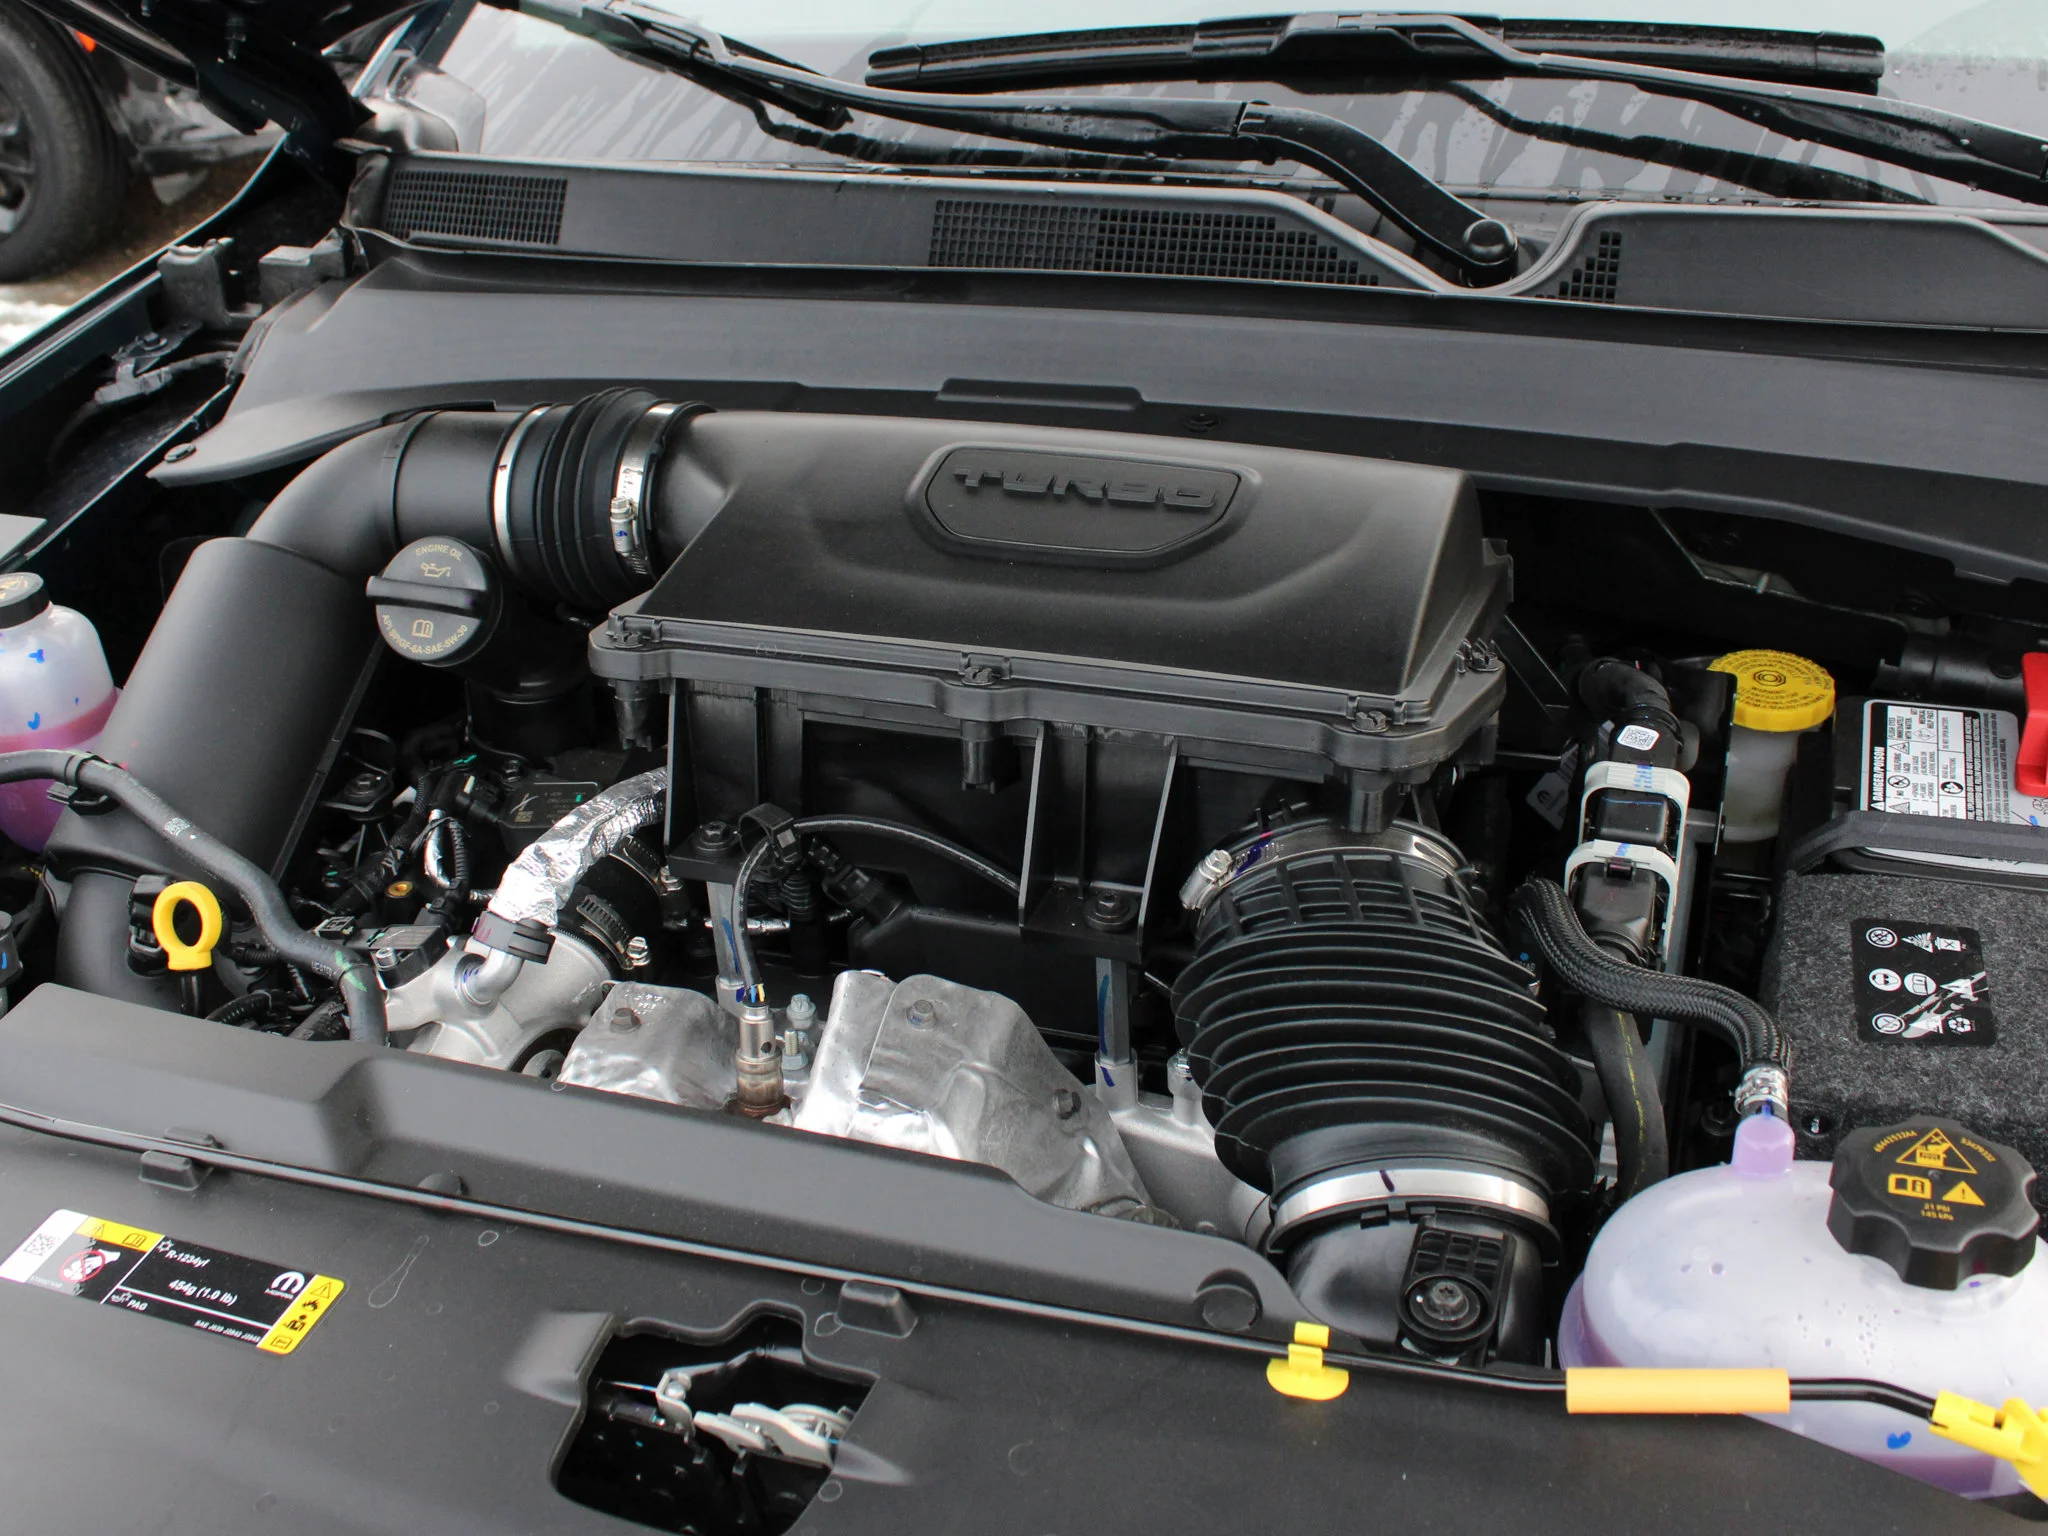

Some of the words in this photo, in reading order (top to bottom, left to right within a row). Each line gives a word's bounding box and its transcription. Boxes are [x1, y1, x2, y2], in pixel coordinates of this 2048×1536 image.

[954, 465, 1217, 509] TURBO
[415, 544, 449, 557] ENGINE
[449, 548, 464, 562] OIL
[381, 614, 393, 630] API
[1872, 746, 1885, 801] DANGER/POISON
[165, 1247, 211, 1269] R-1234yf
[168, 1278, 197, 1297] 454g
[198, 1285, 220, 1302] (1.0
[220, 1289, 238, 1307] lb)
[128, 1298, 148, 1312] PAG
